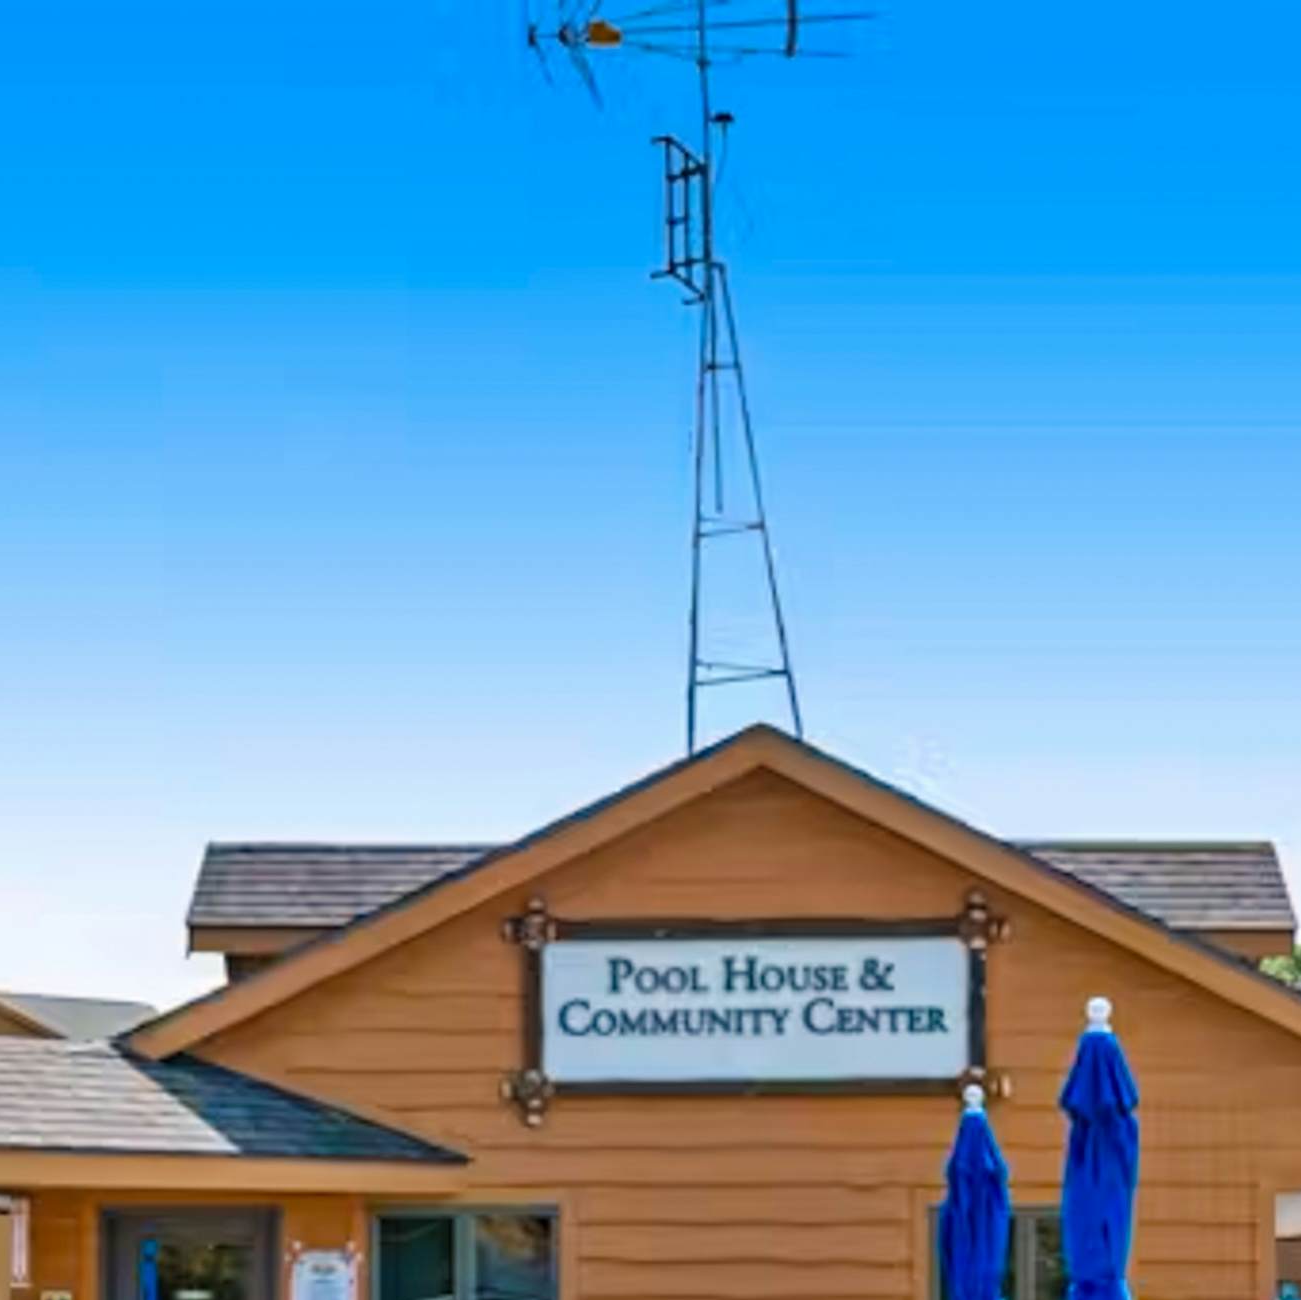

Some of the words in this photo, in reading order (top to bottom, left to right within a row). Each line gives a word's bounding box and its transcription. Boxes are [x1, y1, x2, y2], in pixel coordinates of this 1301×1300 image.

[607, 956, 709, 994] POOL
[722, 955, 850, 992] HOUSE
[859, 957, 895, 992] &
[557, 999, 791, 1037] COMMUNITY
[802, 997, 949, 1035] CENTER
